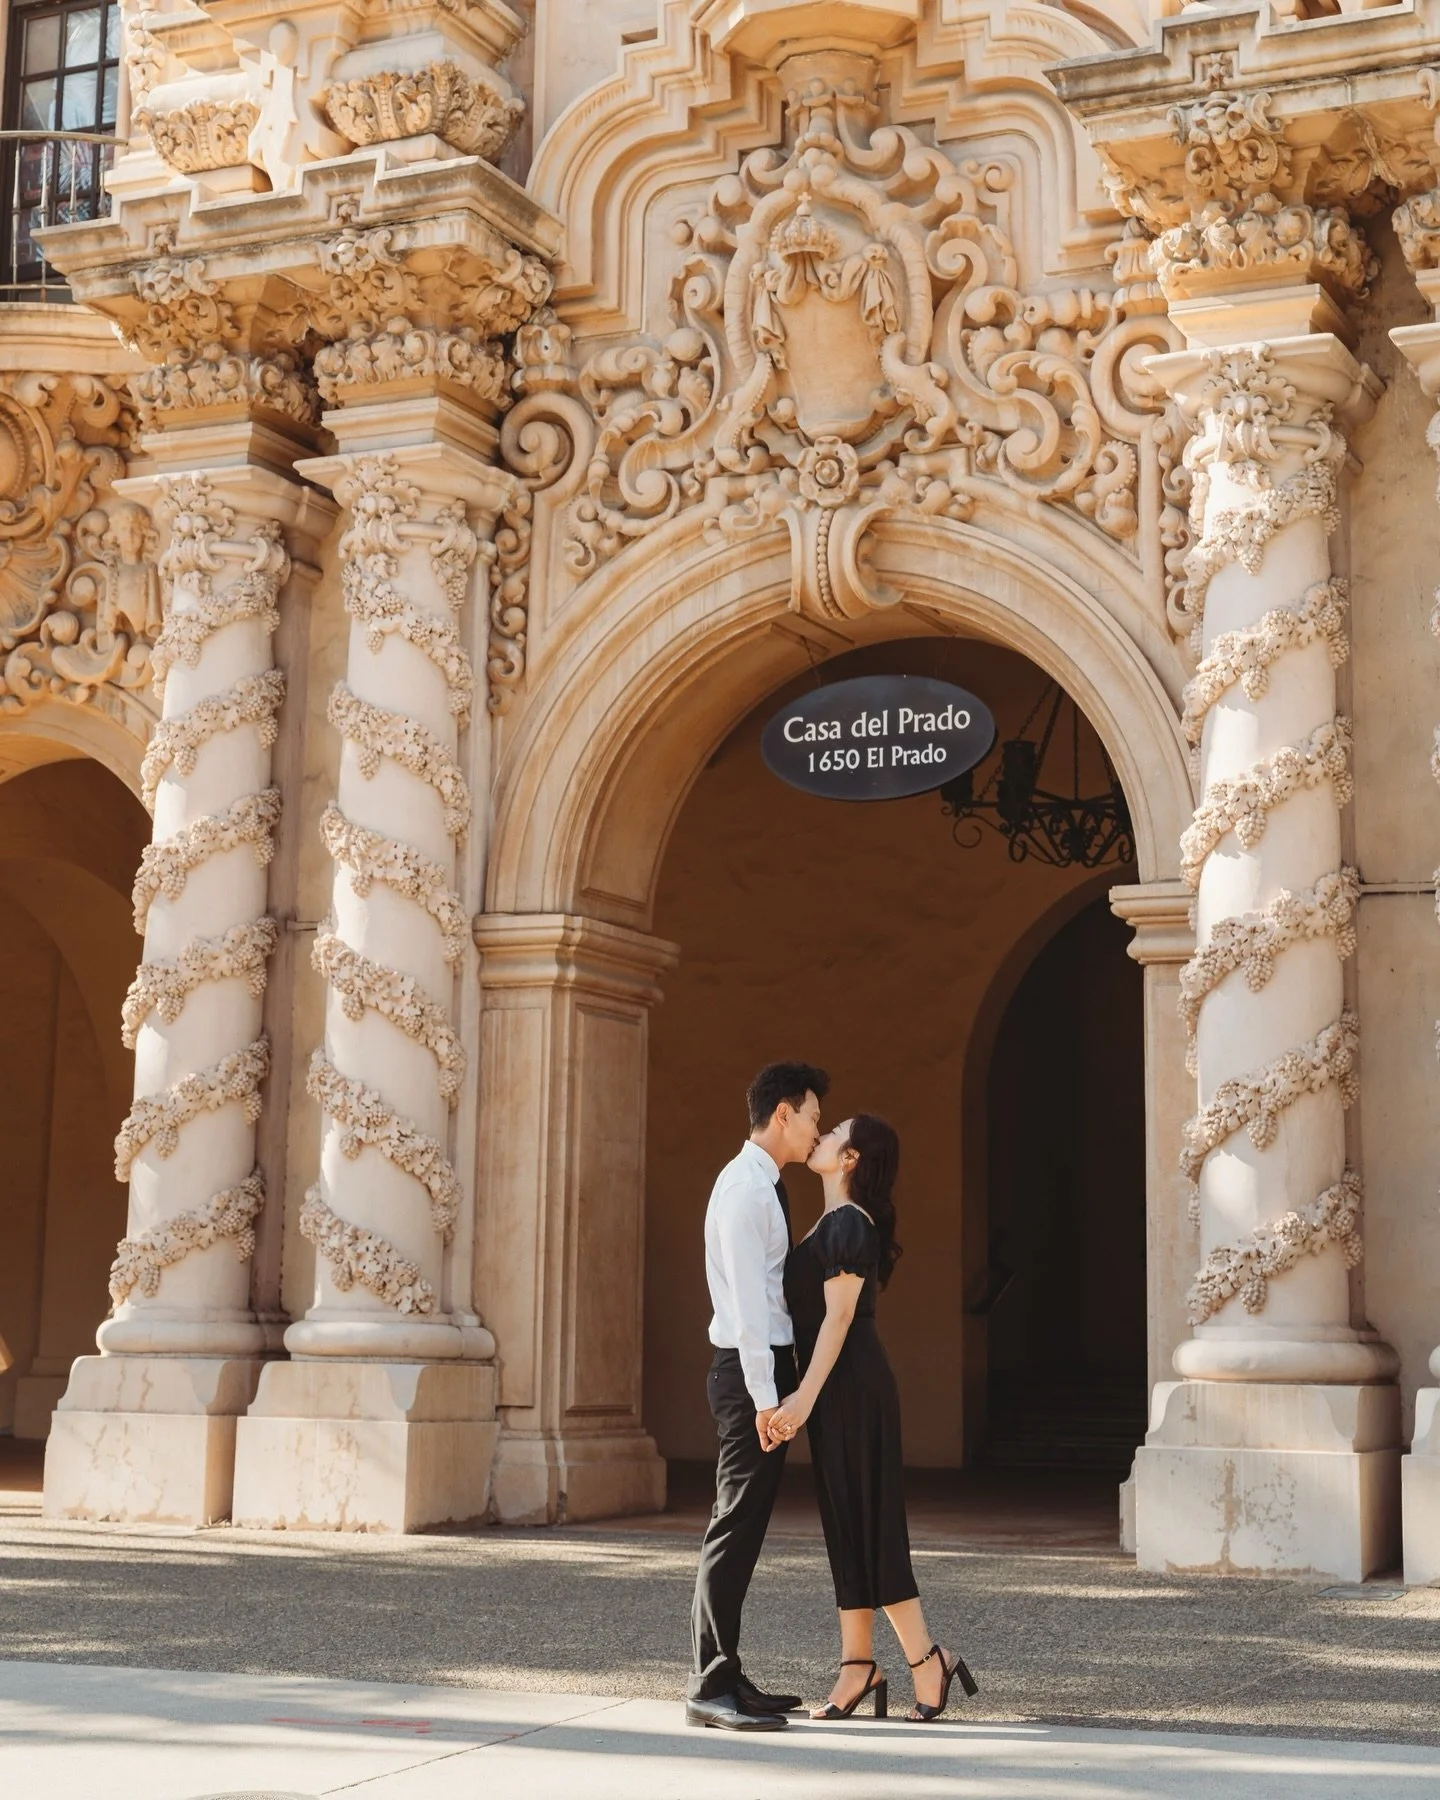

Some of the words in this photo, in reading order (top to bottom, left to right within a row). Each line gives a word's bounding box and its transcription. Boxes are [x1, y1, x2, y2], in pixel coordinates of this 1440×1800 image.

[783, 716, 842, 743] Casa
[851, 709, 889, 738] del
[898, 704, 971, 734] Prado
[808, 748, 860, 773] 1650
[867, 747, 884, 768] El
[891, 743, 947, 767] Prado
